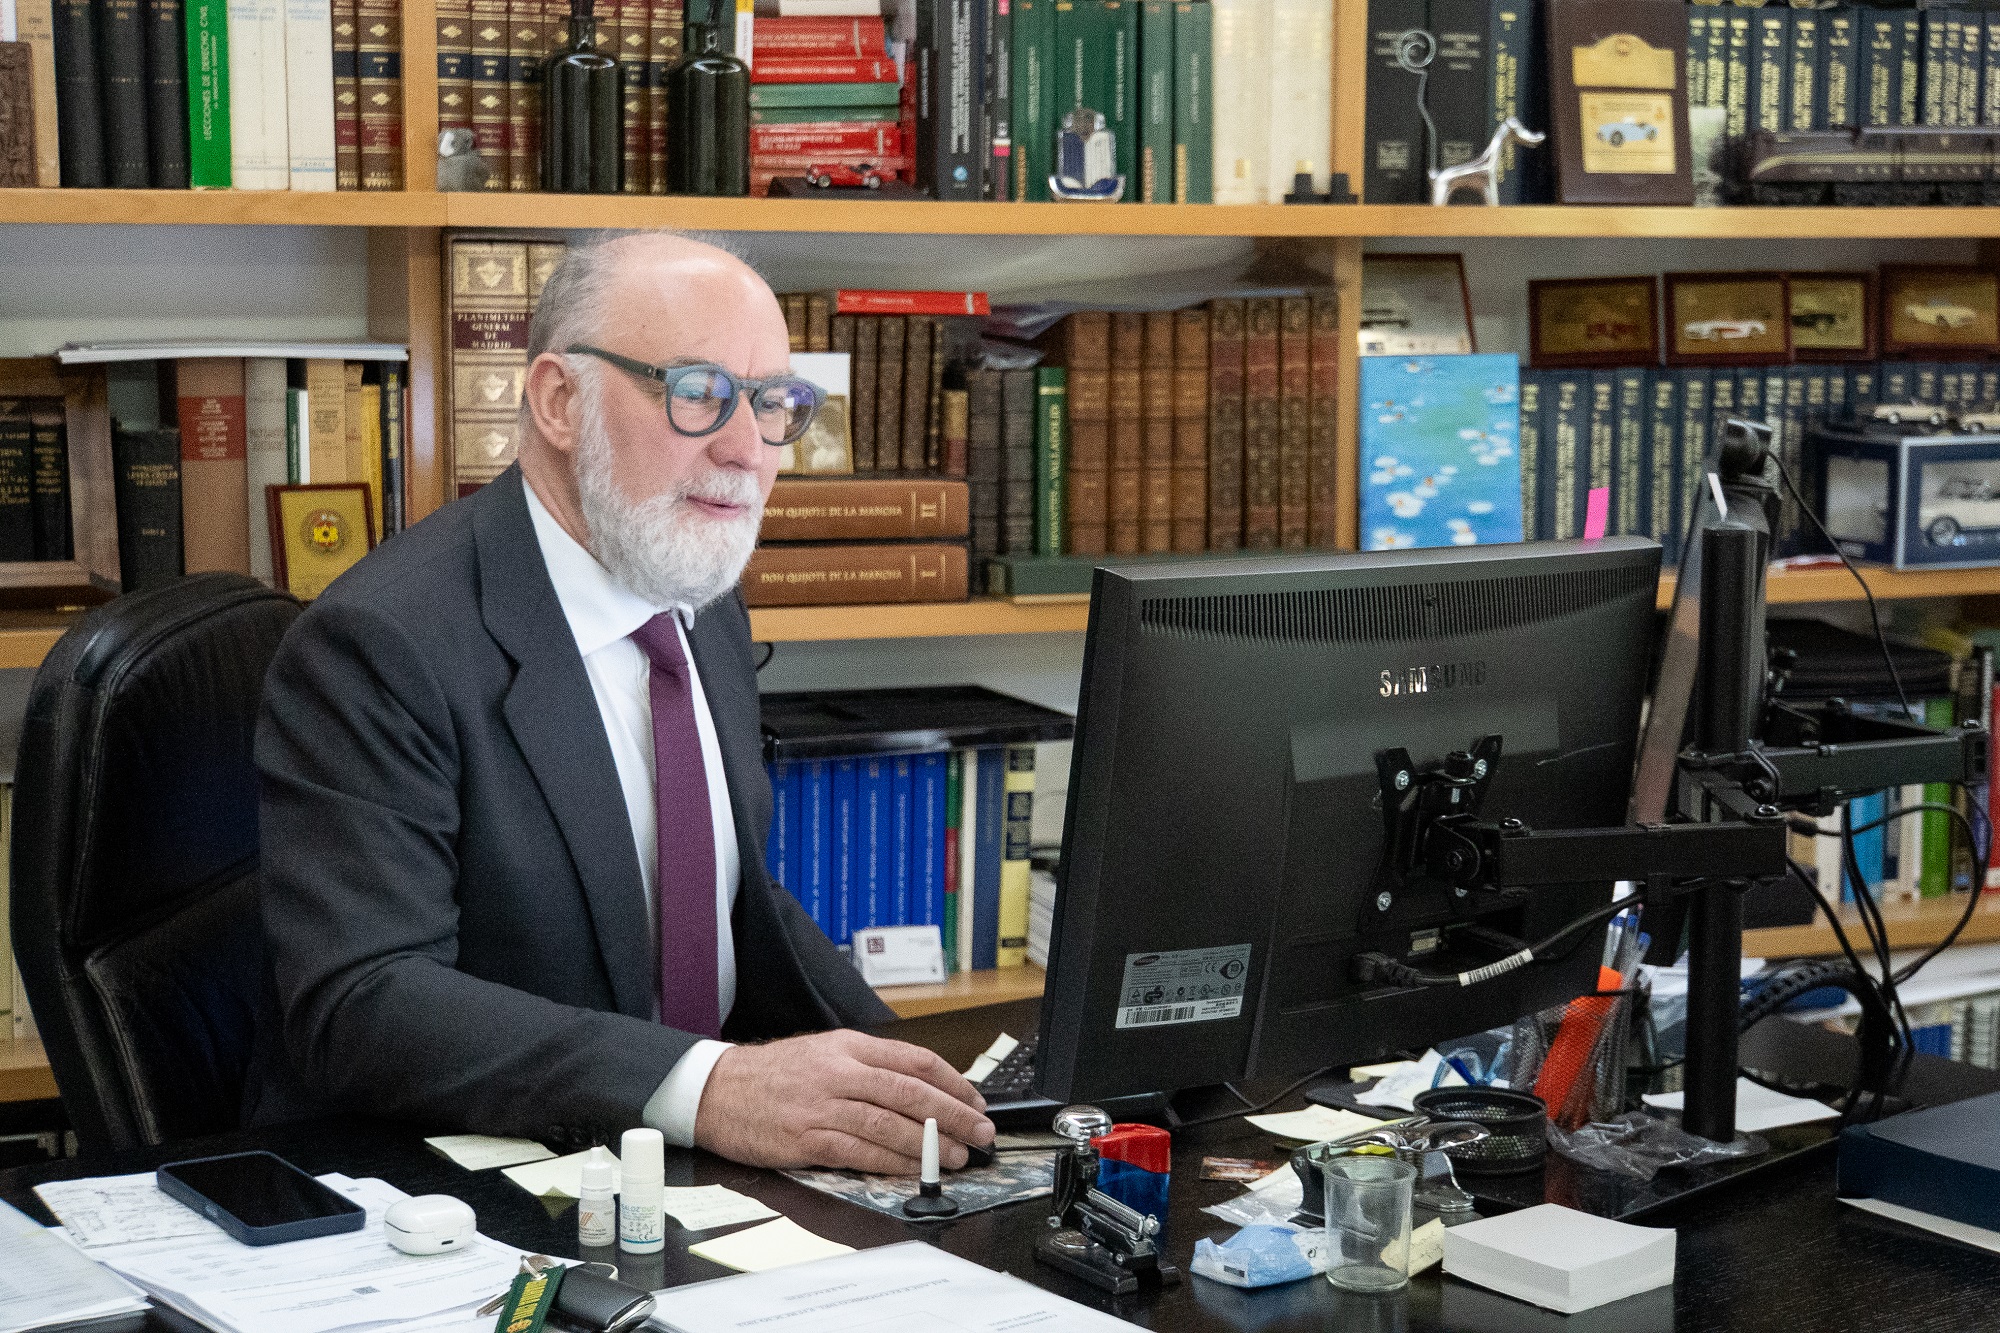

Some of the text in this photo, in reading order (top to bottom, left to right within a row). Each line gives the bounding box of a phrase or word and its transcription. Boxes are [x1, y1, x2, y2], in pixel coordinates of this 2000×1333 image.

[200, 5, 212, 140] LECCIONES DE DERECHO CIVIL
[471, 323, 511, 332] GENERAL
[484, 332, 498, 340] DE
[472, 341, 512, 349] MADRID
[1049, 403, 1061, 480] VALLADOLID
[764, 507, 784, 517] DON
[786, 506, 827, 519] QUIJOTE
[829, 506, 841, 517] DE
[844, 506, 857, 517] LA
[859, 506, 902, 517] MANCHA
[761, 572, 784, 583] DON
[786, 571, 827, 584] QUIJOTE
[829, 571, 841, 582] DE
[844, 570, 857, 581] LA
[859, 569, 902, 581] MANCHA
[1379, 660, 1487, 697] SAMSUNG
